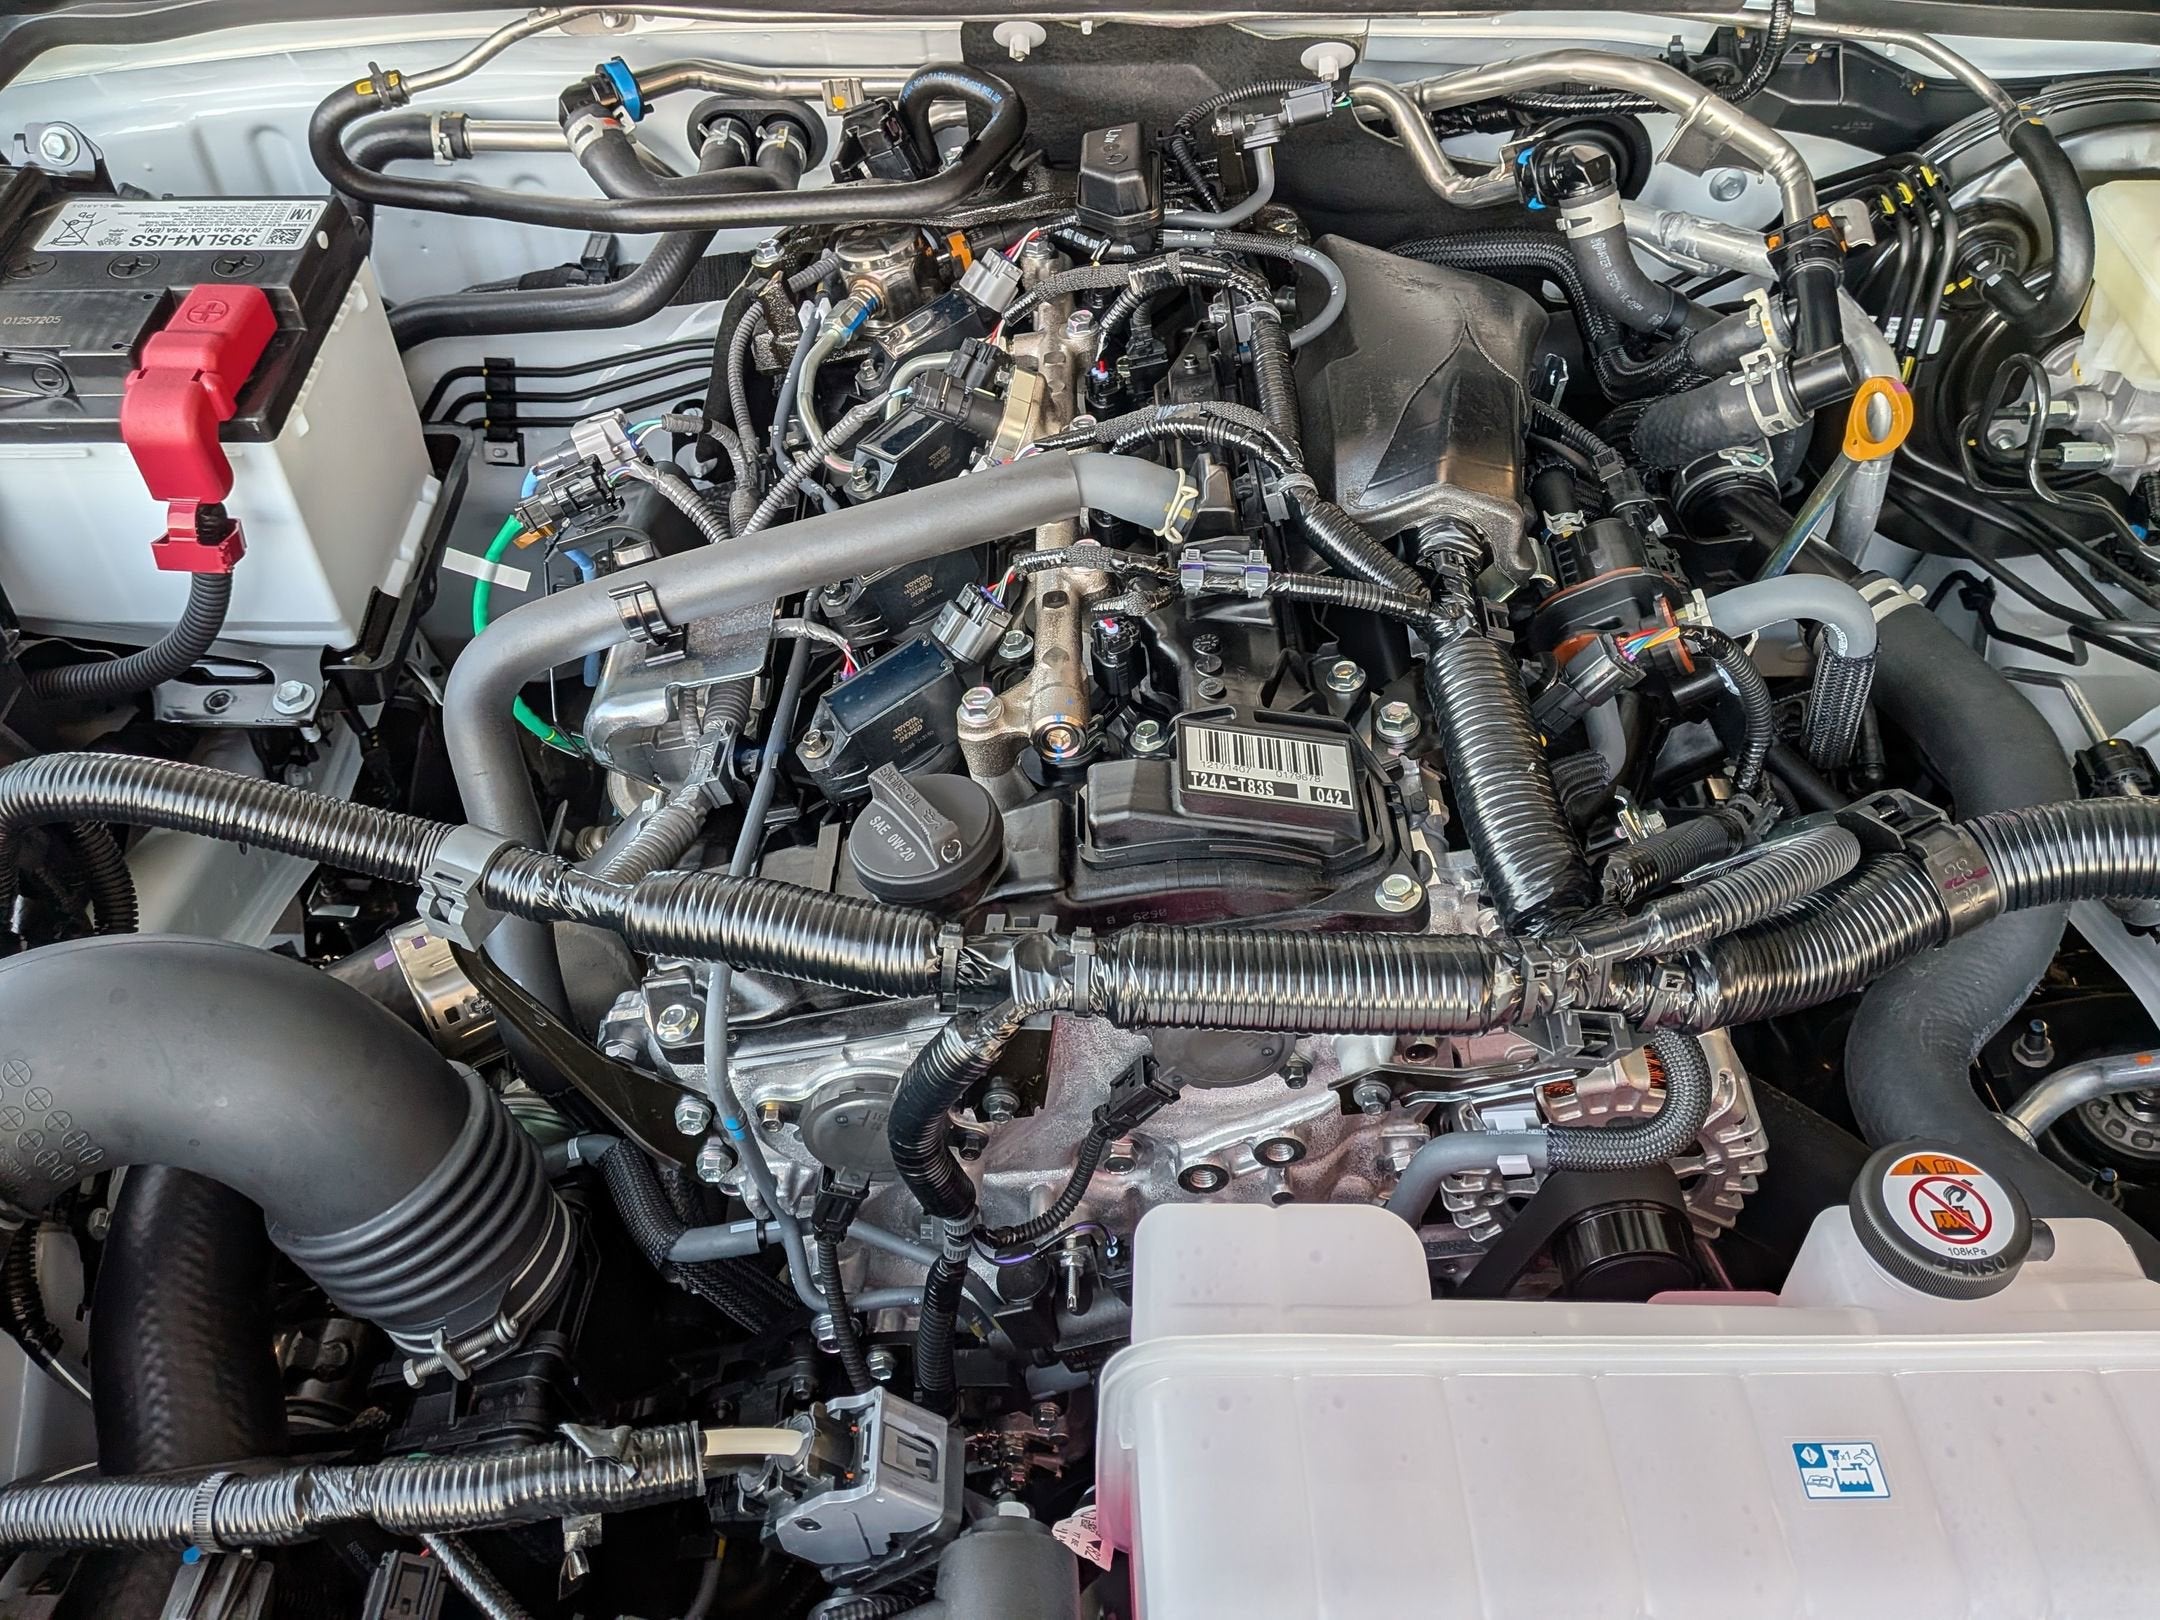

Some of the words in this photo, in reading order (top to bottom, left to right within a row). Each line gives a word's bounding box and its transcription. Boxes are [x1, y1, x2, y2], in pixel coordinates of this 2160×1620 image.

[290, 208, 312, 219] VM
[128, 234, 258, 246] 395LN4-ISS
[3, 315, 63, 325] 01257205
[904, 574, 929, 589] TOYOTA
[910, 582, 933, 598] DENSO
[893, 716, 919, 734] TOYOTA
[899, 724, 923, 743] DENSO
[1201, 761, 1252, 773] 12171407
[880, 767, 910, 795] ENGINE
[904, 792, 920, 809] OIL
[1190, 772, 1275, 796] T24A-T83S
[1316, 788, 1343, 805] 042
[869, 816, 892, 836] SAE
[1947, 1247, 1988, 1256] 108kPa
[1933, 1255, 2007, 1276] DENSO
